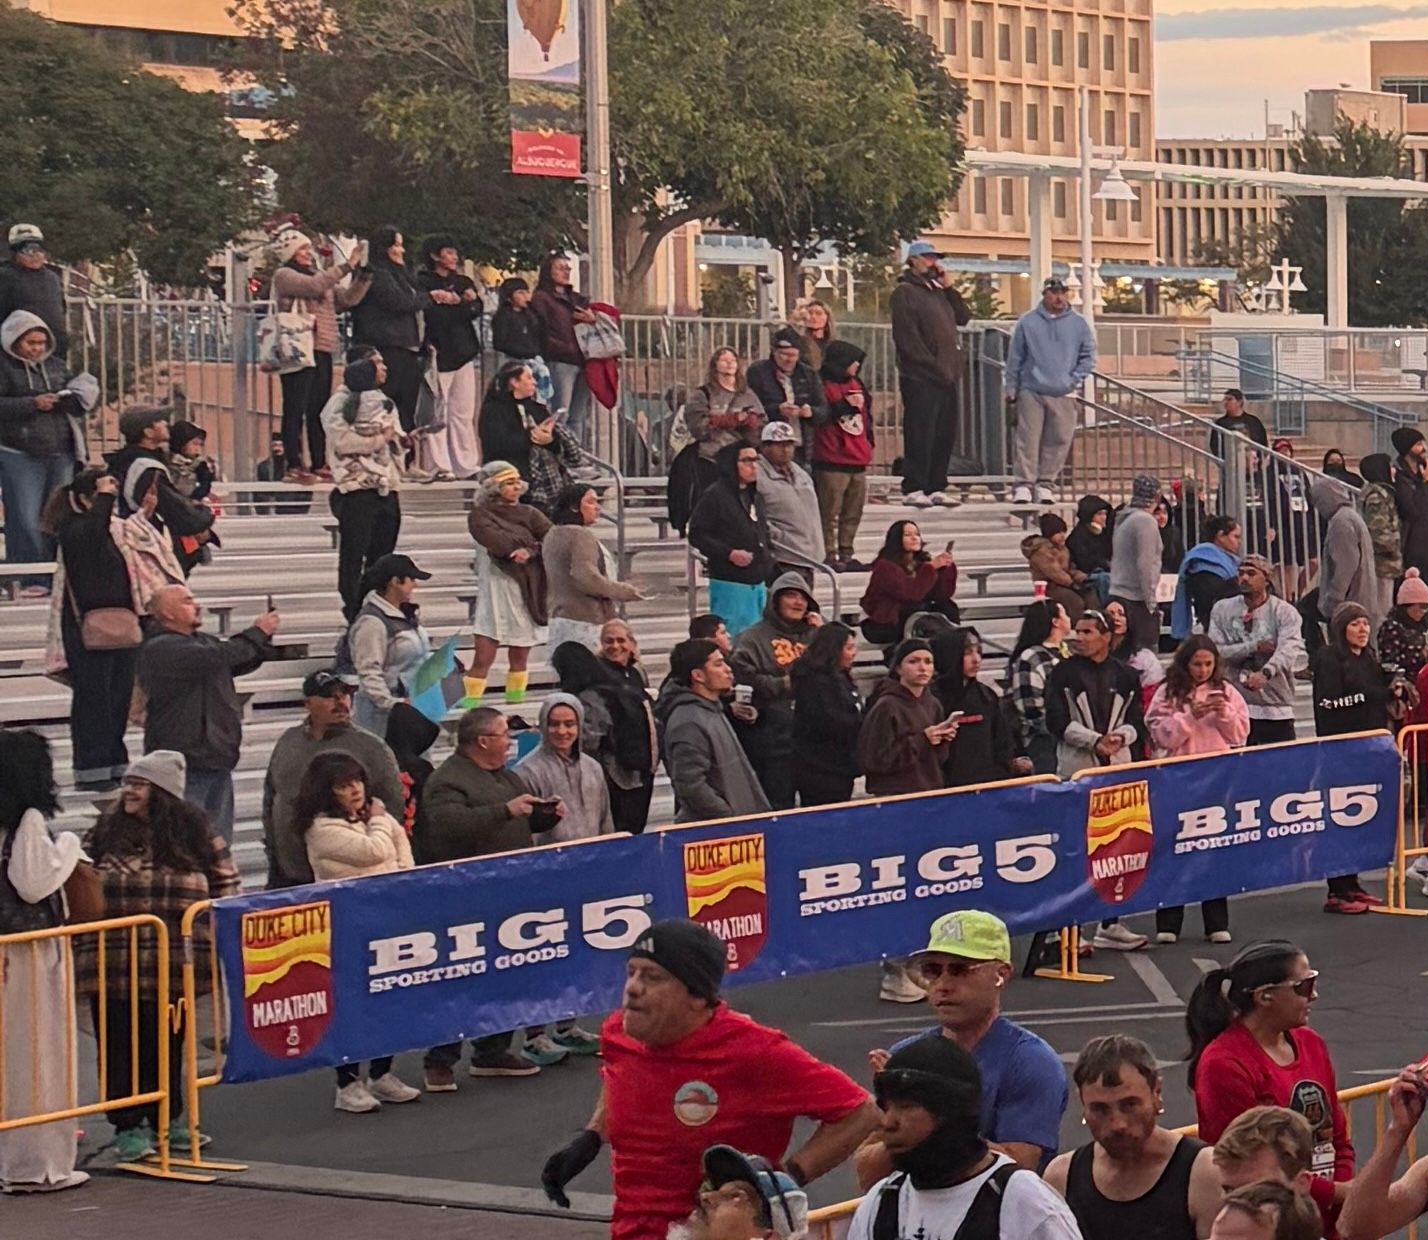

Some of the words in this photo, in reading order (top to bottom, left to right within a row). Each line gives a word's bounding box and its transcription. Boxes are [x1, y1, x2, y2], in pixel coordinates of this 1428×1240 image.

[1120, 782, 1147, 809] CITY
[1176, 790, 1325, 841] BIG
[1329, 784, 1379, 827] 5
[687, 841, 727, 863] DUKE
[728, 836, 763, 861] CITY
[1174, 829, 1261, 855] SPORTING
[1267, 820, 1325, 839] GOODS
[799, 843, 983, 901] BIG
[995, 833, 1056, 883] 5
[1091, 851, 1149, 881] MARATHON
[799, 886, 907, 917] SPORTING
[914, 876, 983, 899] GOODS
[244, 912, 288, 946] DUKE
[298, 906, 329, 938] CITY
[366, 906, 570, 976] BIG
[580, 894, 652, 950] 5
[706, 912, 763, 942] ARATHON
[368, 957, 487, 994] SPORTING
[495, 944, 570, 972] GOODS
[252, 990, 328, 1030] MARATHON
